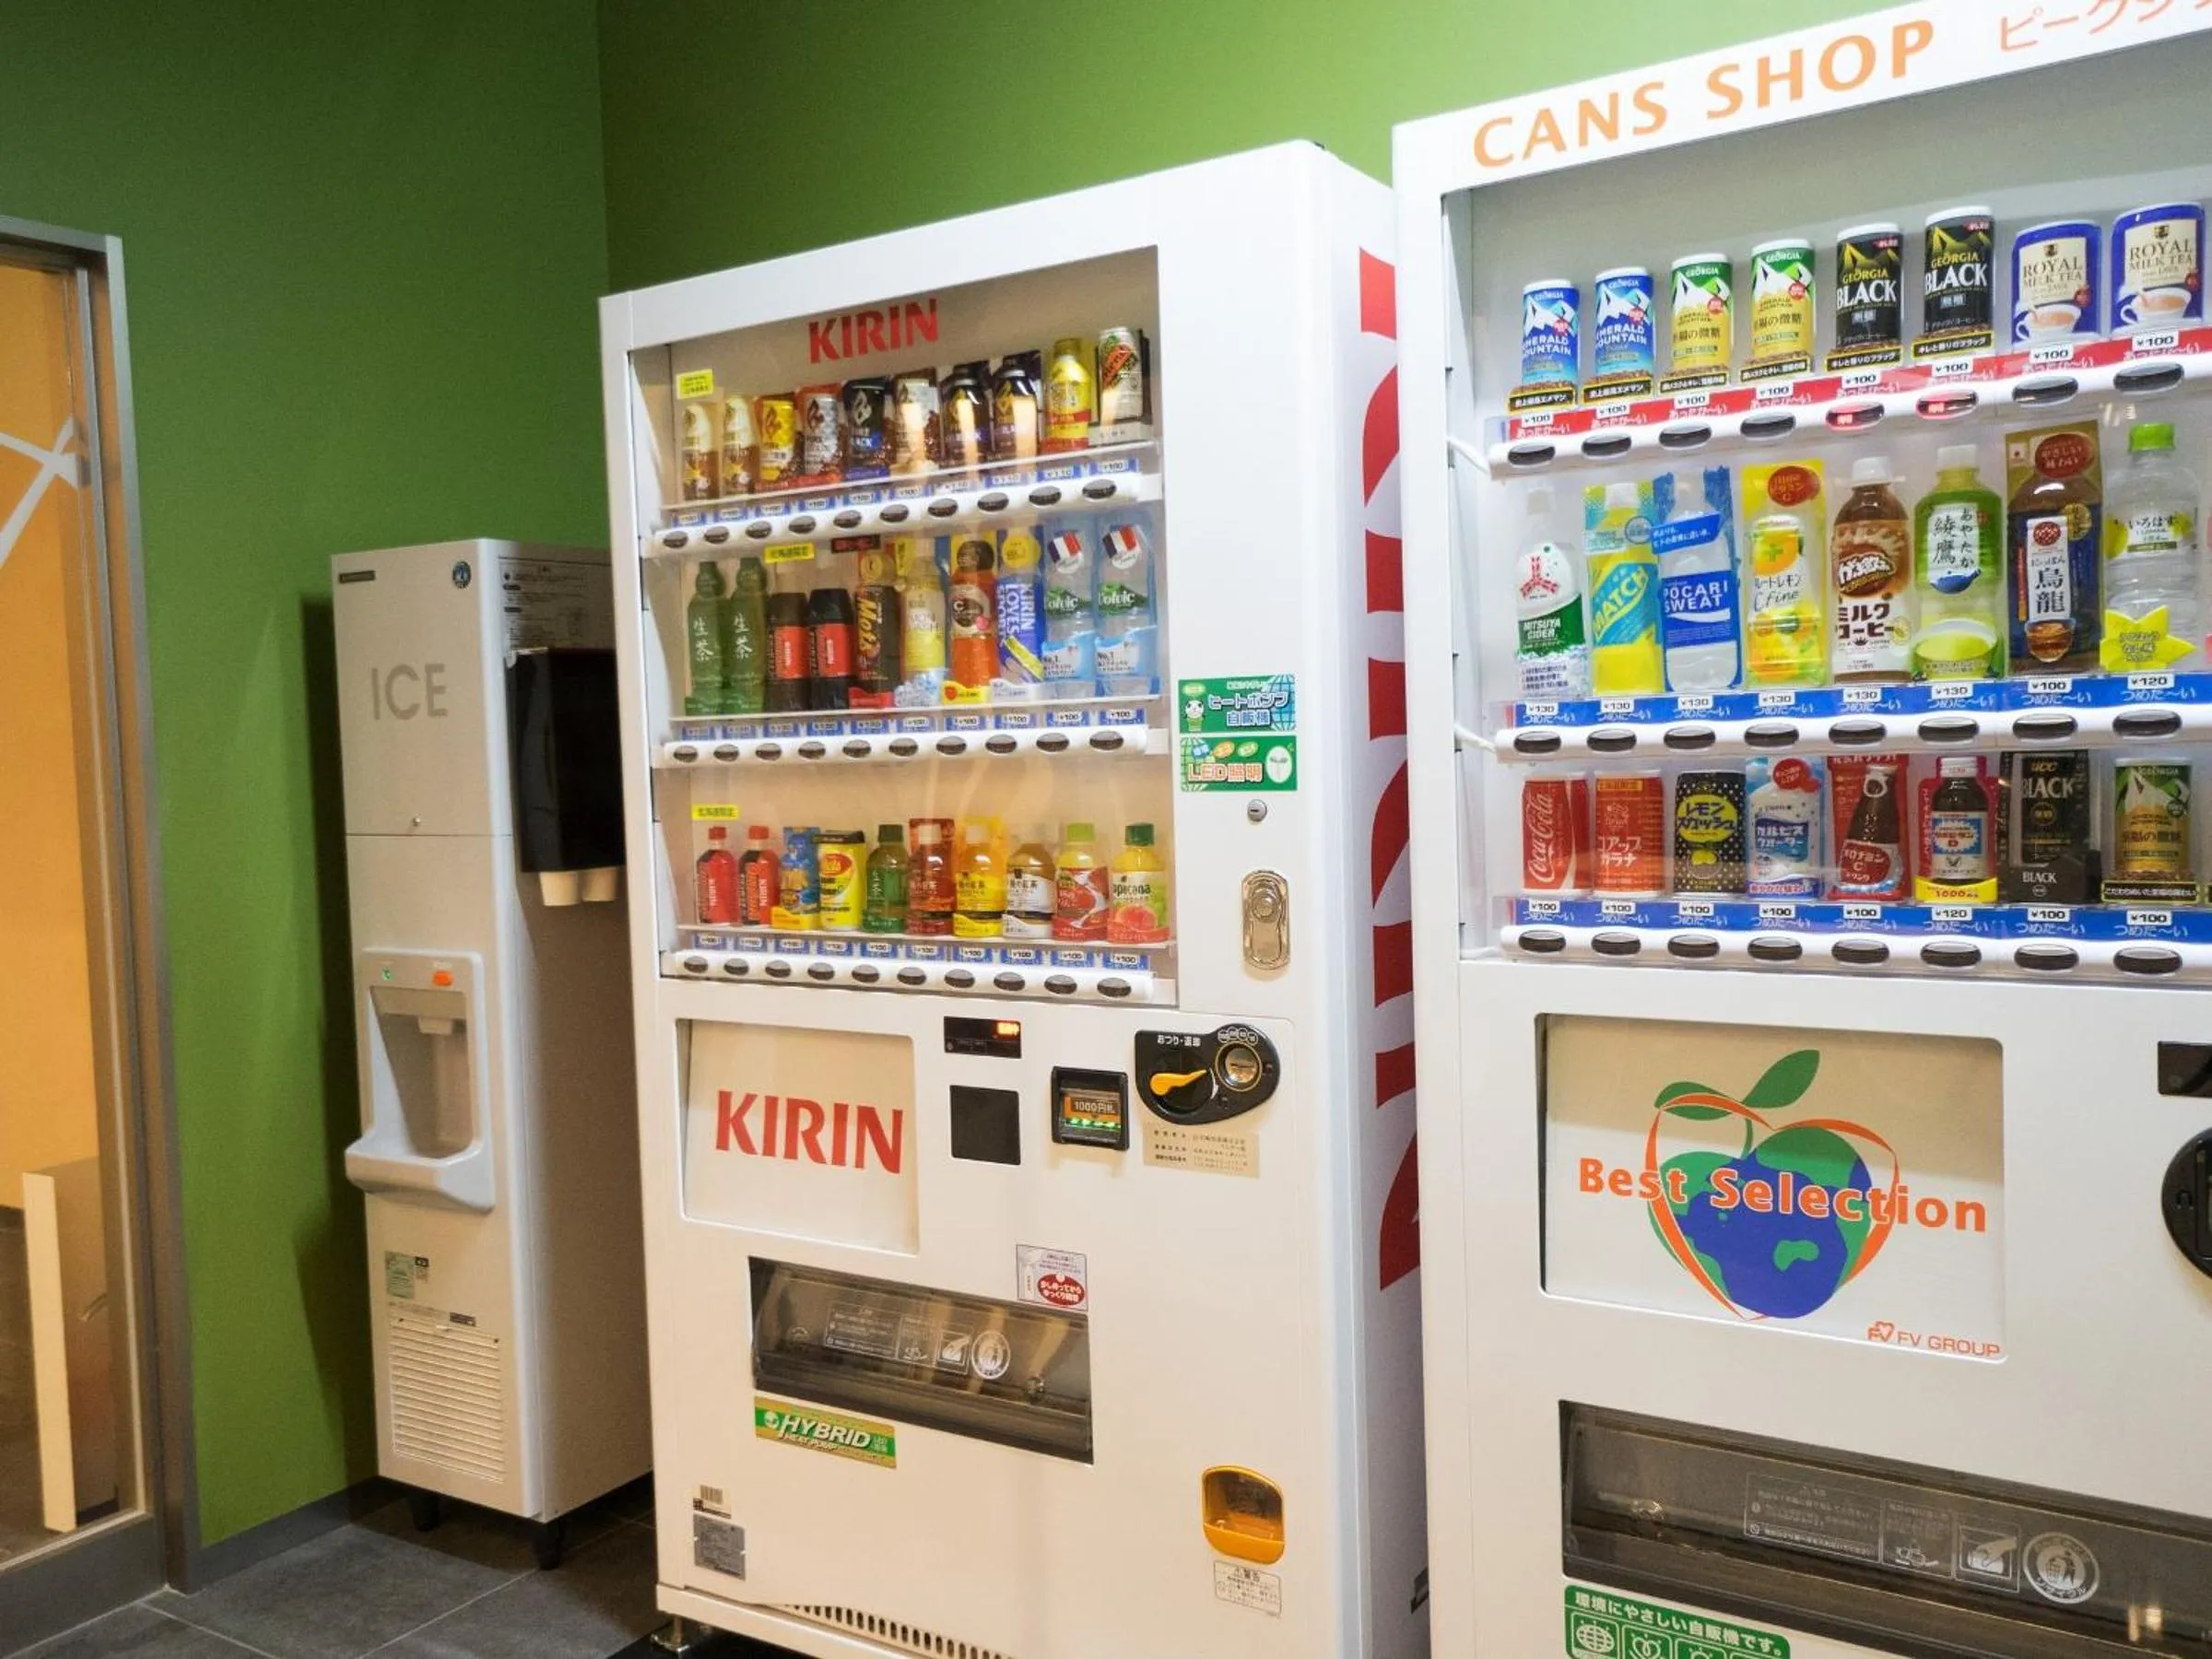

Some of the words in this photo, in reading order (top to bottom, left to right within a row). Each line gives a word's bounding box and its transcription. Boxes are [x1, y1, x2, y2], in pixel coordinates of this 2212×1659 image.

[1474, 81, 1668, 169] CANS
[1706, 19, 1934, 120] SHOP
[2129, 238, 2193, 262] ROYAL
[1931, 252, 1979, 268] GEORGIA
[2023, 256, 2082, 278] ROYAL
[2169, 254, 2193, 266] TEA
[1842, 268, 1888, 284] GEORGIA
[1924, 263, 1988, 294] BLACK
[2059, 272, 2082, 283] TEA
[1836, 279, 1897, 309] BLACK
[807, 297, 939, 364] KIRIN
[1524, 334, 1570, 347] MERALD
[2136, 335, 2175, 347] ¥100
[2033, 349, 2069, 360] ¥100
[1936, 363, 1969, 373] ¥100
[1845, 373, 1877, 384] ¥100
[1759, 385, 1790, 396] ¥100
[1677, 395, 1706, 405] ¥100
[1599, 405, 1628, 415] ¥100
[1524, 414, 1550, 424] ¥100
[1934, 514, 1957, 565] 綾鷹
[1959, 508, 1975, 569] あやたか
[1663, 579, 1729, 600] POCARI
[2034, 567, 2065, 615] 烏龍
[1006, 583, 1022, 635] LOVES
[1018, 582, 1036, 631] KIRIN
[1045, 594, 1079, 610] olvic
[1593, 564, 1649, 641] MATCH
[1664, 594, 1724, 614] SWEAT
[1838, 603, 1890, 621] ミルク
[734, 612, 753, 659] 生茶
[1838, 622, 1895, 641] コーヒー
[693, 616, 714, 662] 生茶
[2031, 679, 2067, 691] ¥100
[2131, 676, 2168, 688] ¥120
[370, 662, 448, 721] ICE
[1846, 690, 1877, 700] ¥130
[1936, 685, 1969, 696] ¥130
[1680, 697, 1709, 707] ¥130
[1762, 694, 1792, 703] ¥130
[1529, 705, 1555, 713] ¥130
[1604, 701, 1630, 711] ¥130
[1226, 709, 1271, 726] 自販機
[2030, 760, 2058, 772] UCC
[2022, 776, 2074, 799] BLACK
[1686, 801, 1726, 818] レモン
[1677, 817, 1734, 832] スカッシュ
[1757, 824, 1804, 837] カルピス
[1526, 792, 1556, 883] Coca-Cola
[1757, 837, 1804, 849] ウォーター
[1852, 861, 1865, 872] C
[2022, 871, 2057, 884] BLACK
[1531, 903, 1557, 912] ¥100
[1605, 904, 1631, 912] ¥100
[1681, 905, 1710, 913] ¥100
[1762, 908, 1792, 916] ¥100
[1846, 908, 1877, 917] ¥100
[1936, 909, 1967, 918] ¥120
[2031, 910, 2065, 919] ¥100
[2131, 912, 2168, 923] ¥100
[715, 1088, 904, 1175] KIRIN
[1579, 1157, 1688, 1204] Best
[1710, 1168, 1986, 1232] Selection
[1897, 1330, 1922, 1347] FV
[1927, 1335, 2001, 1358] GROUP
[777, 1414, 872, 1449] HYBRID
[1575, 1591, 1783, 1657] 環境にやさしい自販機です。
